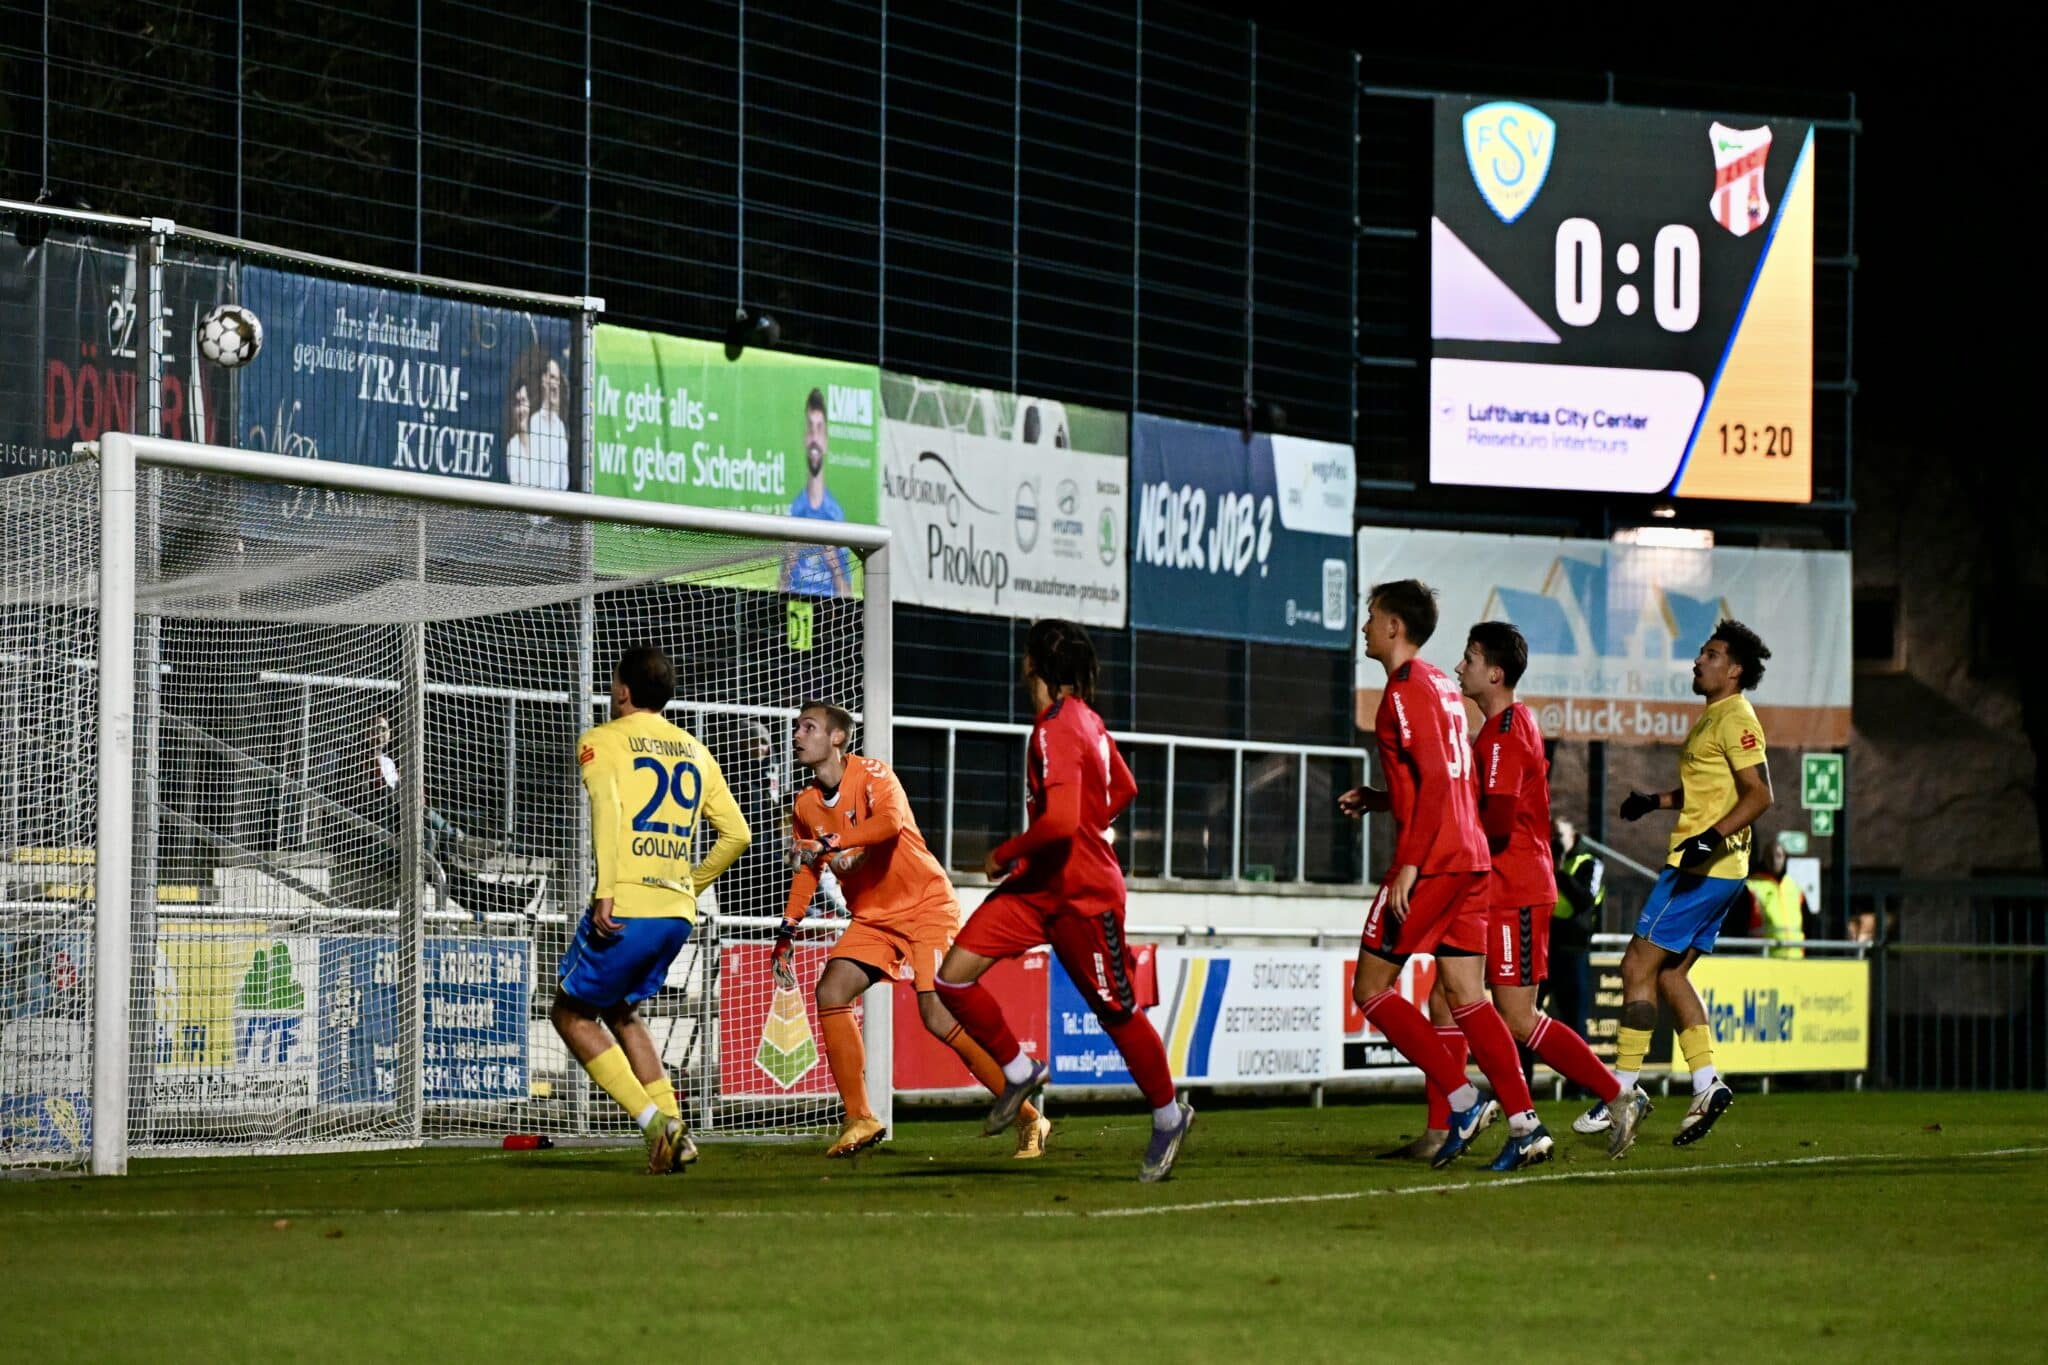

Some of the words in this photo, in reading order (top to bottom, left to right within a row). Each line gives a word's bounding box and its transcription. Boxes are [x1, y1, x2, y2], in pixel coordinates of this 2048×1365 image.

[1555, 217, 1701, 332] 0:0
[333, 306, 363, 341] Ihre
[367, 307, 440, 352] individuell
[293, 337, 357, 374] geplante
[47, 343, 185, 441] DÖNR
[357, 353, 470, 412] TRAUM-
[597, 374, 621, 416] Ihr
[625, 382, 665, 432] gebt
[669, 387, 705, 430] alles
[1468, 404, 1550, 425] Lufthansa
[1555, 408, 1588, 429] City
[1593, 410, 1648, 430] Center
[393, 412, 495, 478] KÜCHE
[597, 430, 628, 475] wir
[632, 436, 686, 492] geben
[692, 440, 785, 495] Sicherheit!
[1719, 423, 1794, 459] 13:20
[631, 756, 703, 838] 29
[440, 943, 492, 984] KRÜGER
[1253, 957, 1321, 990] STÄDTISCHE
[431, 996, 495, 1029] Werkstatt
[1225, 1006, 1321, 1034] BETRIEBSWERKE
[1237, 1048, 1321, 1076] LUCKENWALDE
